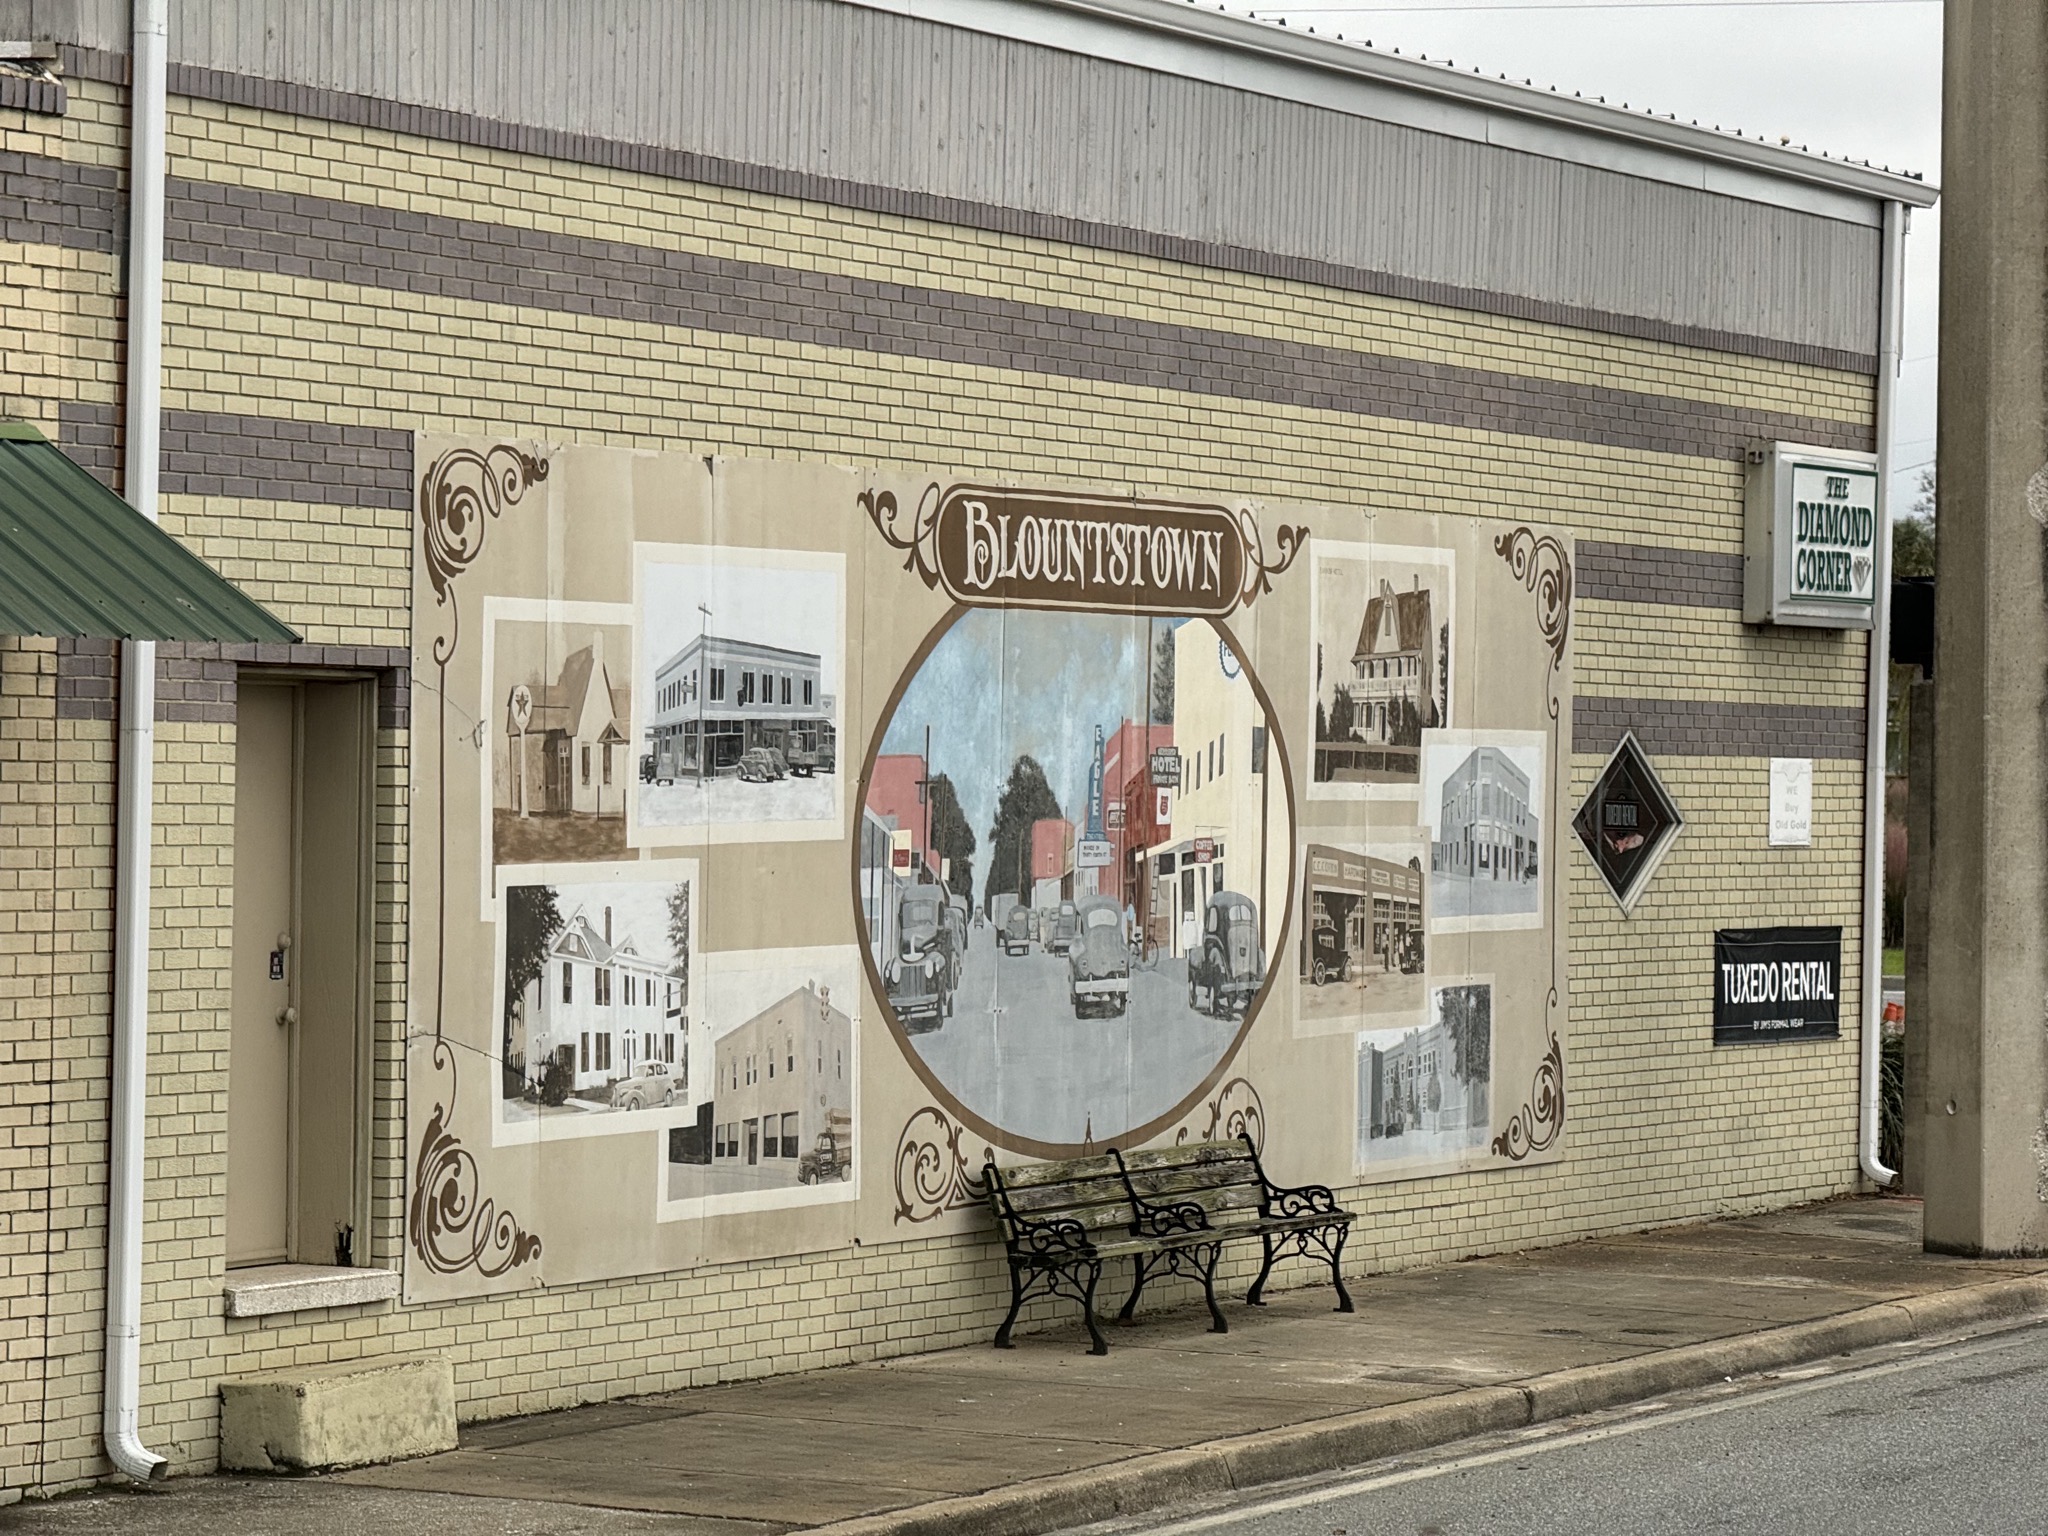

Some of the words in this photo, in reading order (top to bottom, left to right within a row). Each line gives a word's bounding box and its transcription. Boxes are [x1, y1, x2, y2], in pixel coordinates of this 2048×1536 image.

[1827, 476, 1850, 499] THE
[1797, 501, 1873, 547] DIAMOND
[962, 500, 1224, 597] BLOUNTSTOWN
[1797, 548, 1852, 592] CORNER
[1092, 727, 1101, 816] EAGLE
[1151, 756, 1180, 773] HOTEL
[1775, 820, 1788, 829] Old
[1790, 820, 1807, 829] Gold
[1722, 961, 1779, 1004] TUXEDO
[1781, 961, 1835, 1002] RENTAL
[1789, 1017, 1804, 1028] WEAR
